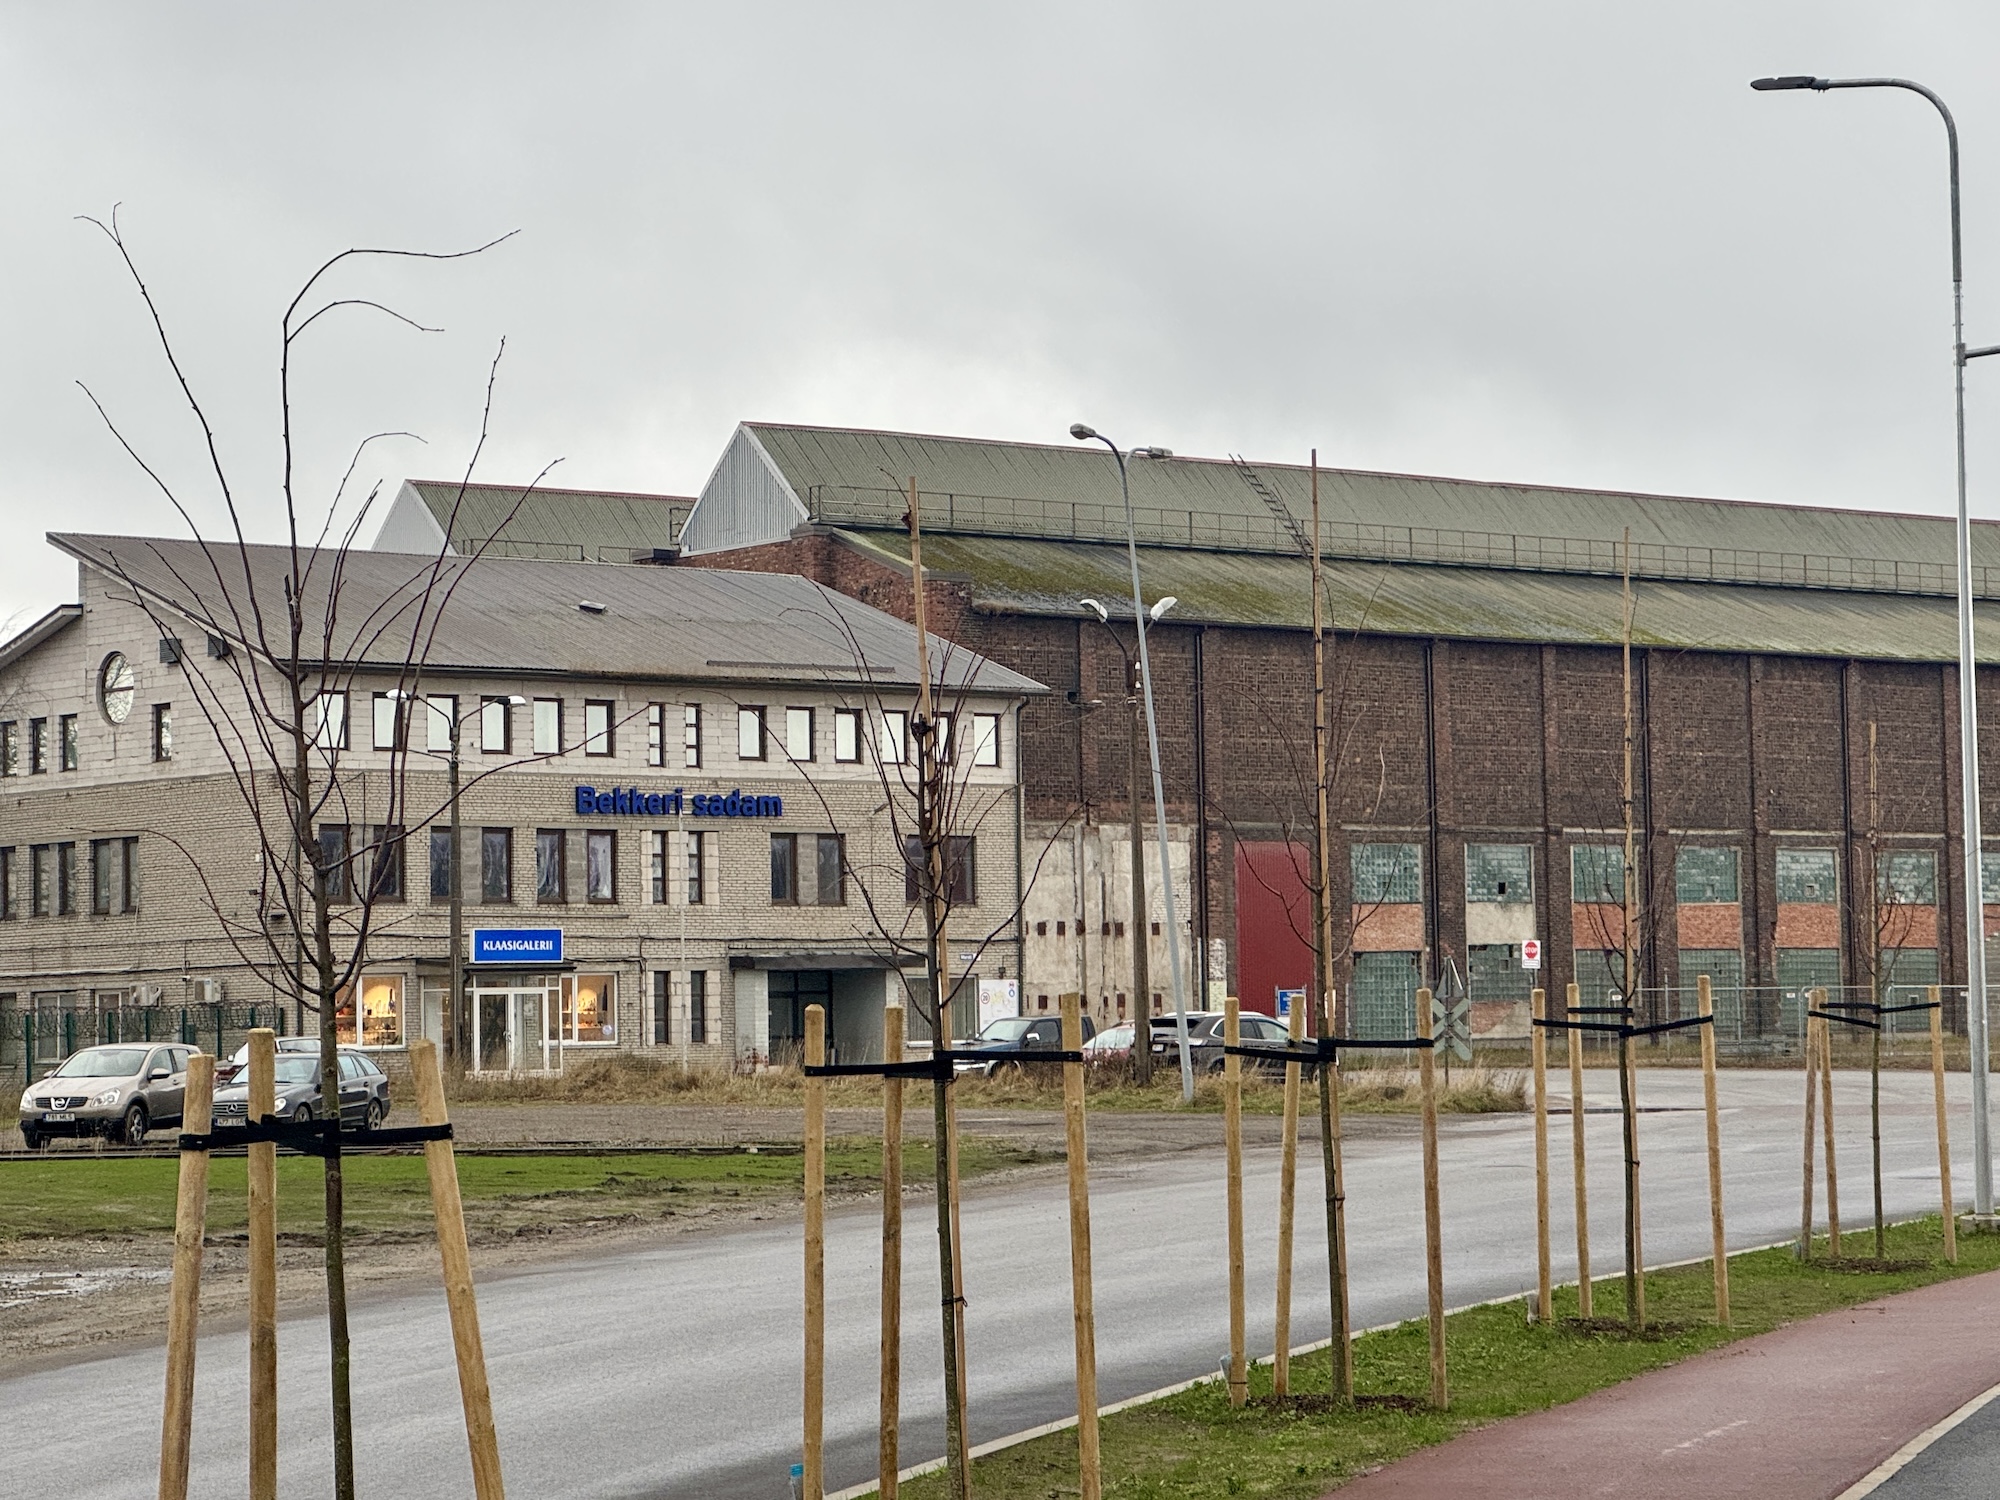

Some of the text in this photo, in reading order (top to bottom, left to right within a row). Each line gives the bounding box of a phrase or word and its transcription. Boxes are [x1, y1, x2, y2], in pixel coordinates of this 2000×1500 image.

[575, 786, 782, 816] Bekkeri sadam
[483, 940, 553, 951] KLAASIGALERII
